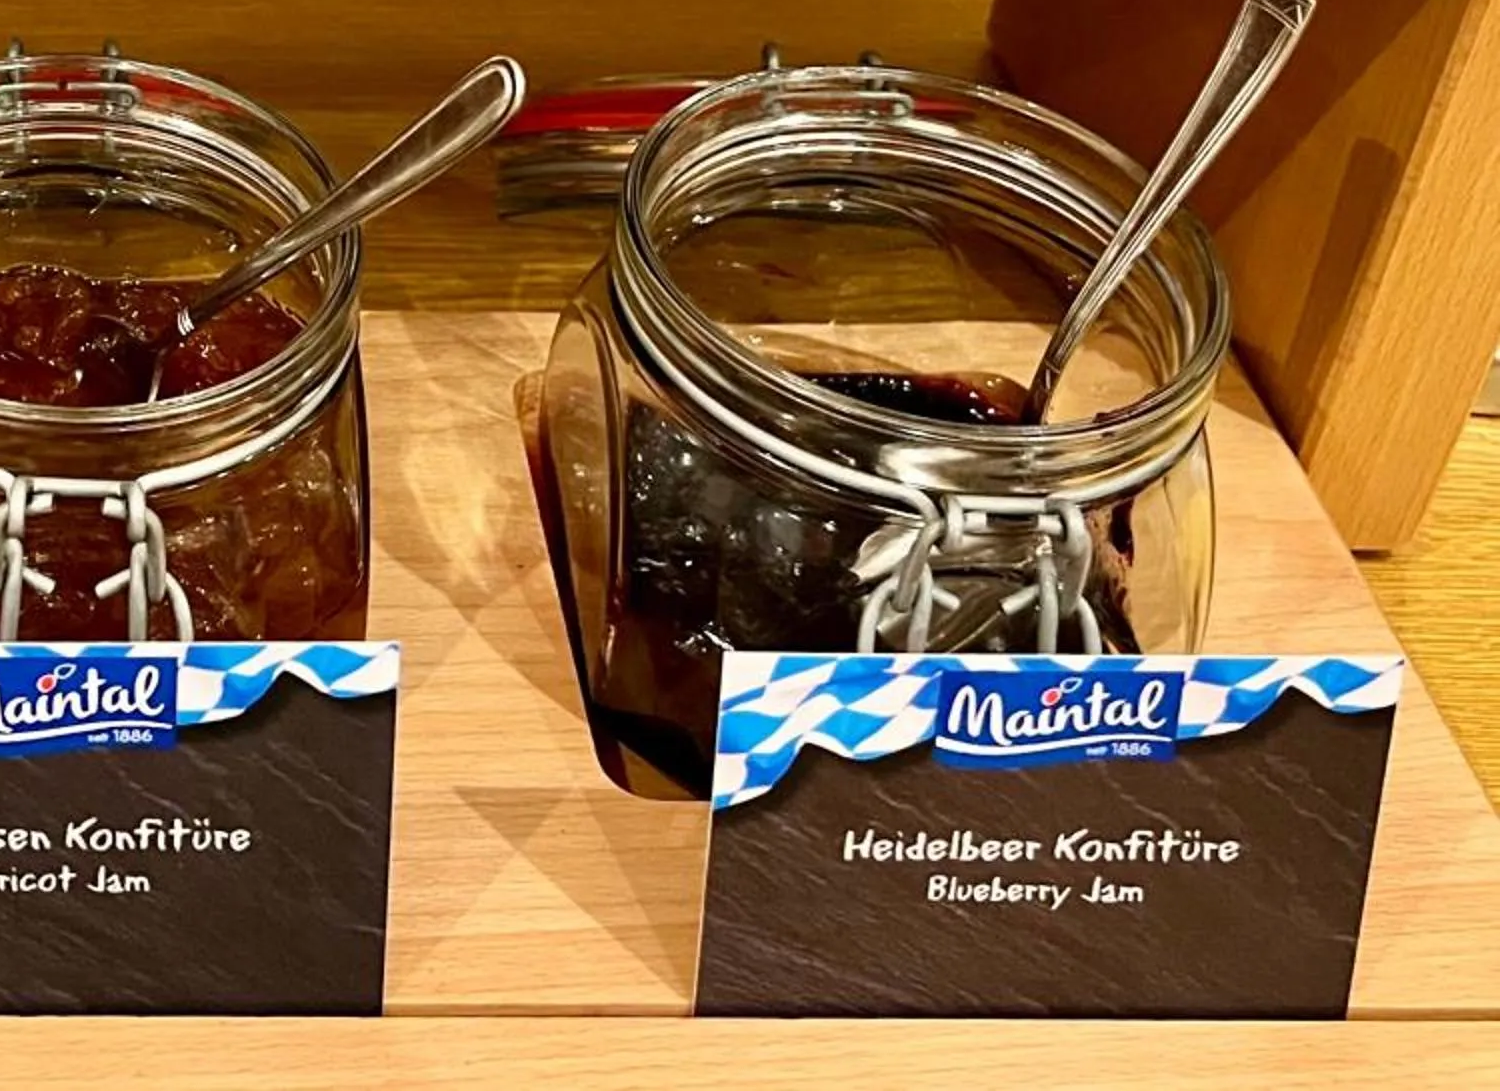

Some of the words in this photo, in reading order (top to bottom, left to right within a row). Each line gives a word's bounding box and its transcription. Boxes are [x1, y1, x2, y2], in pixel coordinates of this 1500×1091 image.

[946, 680, 1168, 746] Maintal
[113, 728, 153, 743] 1886
[1111, 742, 1151, 756] 1886
[65, 816, 251, 852] Konfitüre
[843, 828, 1042, 862] Heidelbeer
[1053, 828, 1241, 863] Konfitüre
[87, 865, 151, 894] Jam
[927, 874, 1072, 911] Blueberry
[1080, 875, 1144, 904] Jam
